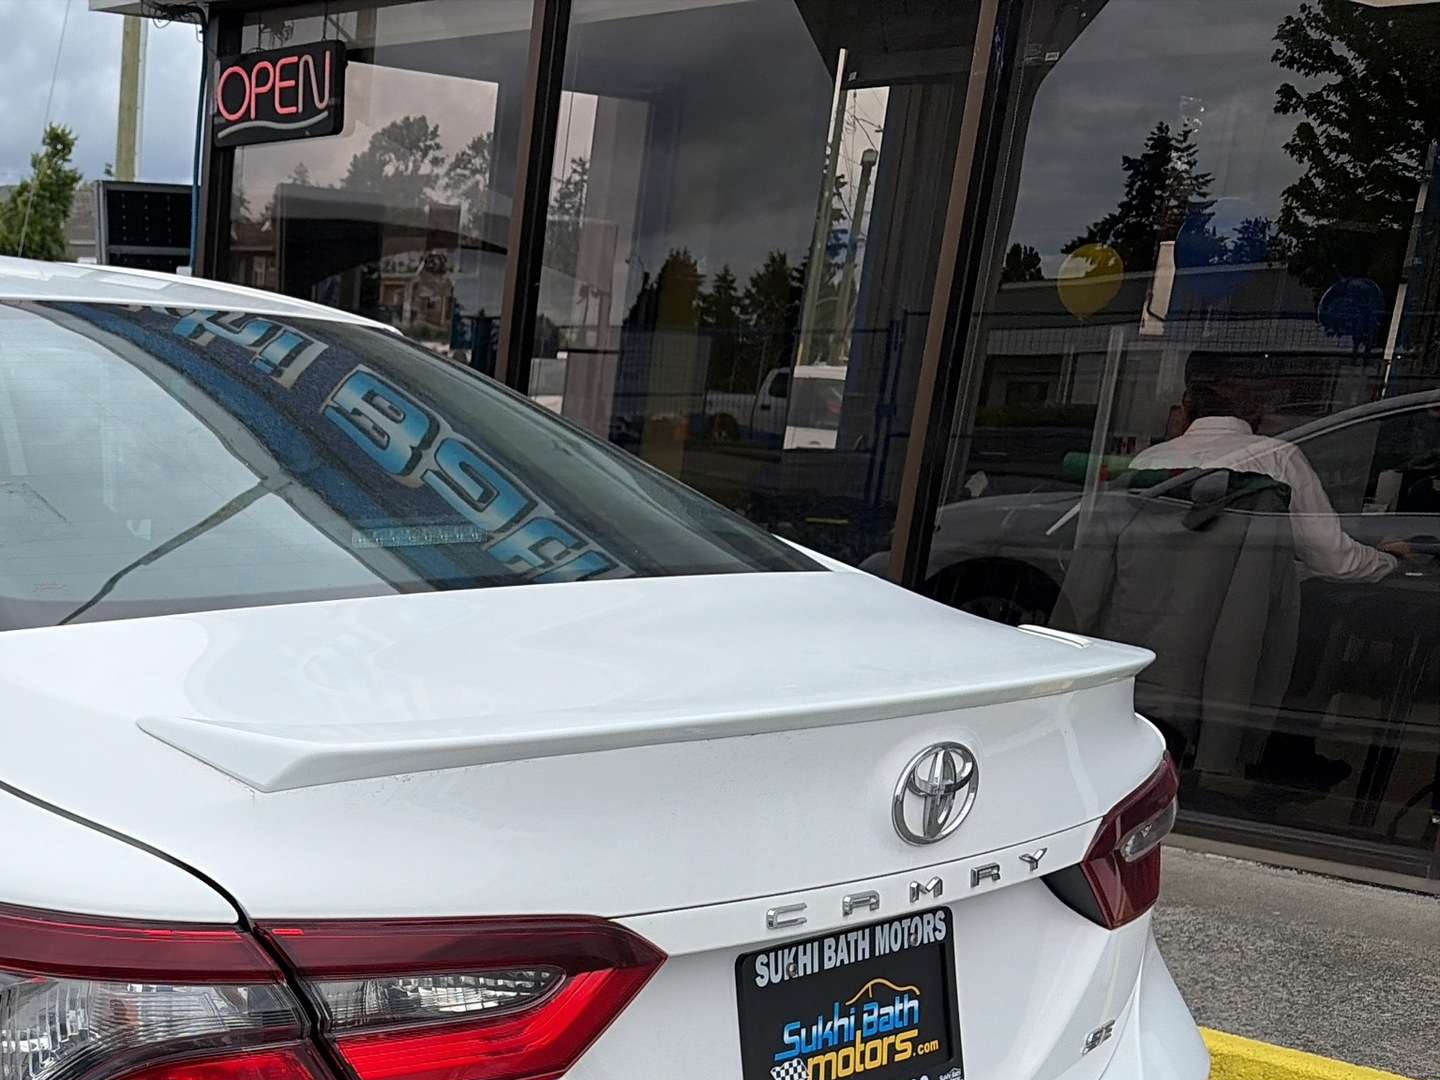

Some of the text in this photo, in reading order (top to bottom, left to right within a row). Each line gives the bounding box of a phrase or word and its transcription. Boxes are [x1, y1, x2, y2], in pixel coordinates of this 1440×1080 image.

[217, 50, 331, 121] OPEN
[766, 848, 1048, 930] CAMRY
[755, 910, 947, 988] SUKHI BATH MOTORS
[774, 993, 920, 1061] Sukhi Bath
